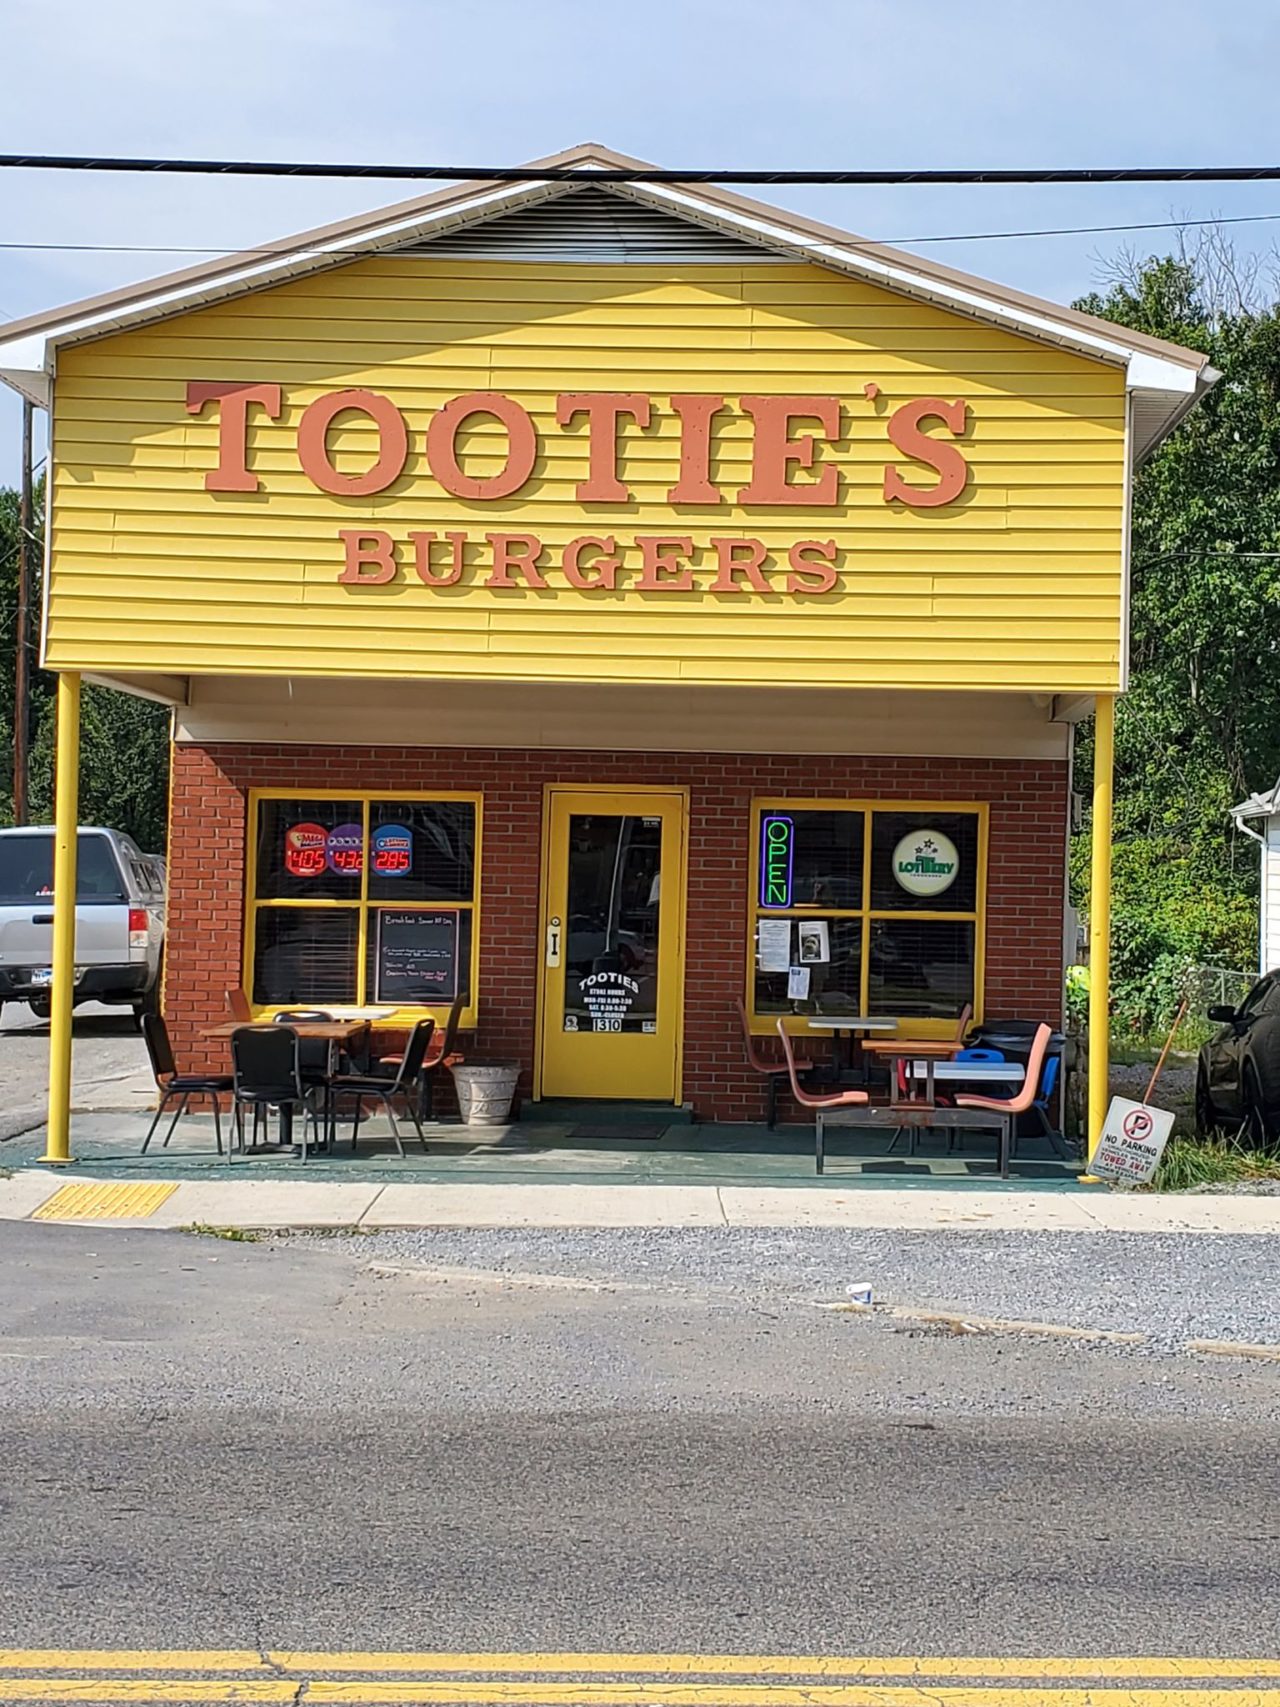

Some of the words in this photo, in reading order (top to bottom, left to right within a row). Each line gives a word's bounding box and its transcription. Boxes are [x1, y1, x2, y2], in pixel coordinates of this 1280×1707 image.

[186, 383, 967, 508] TOOTIE'S
[338, 529, 839, 594] BURGERS
[768, 822, 788, 904] OPEN
[898, 855, 955, 875] LOTTERY
[579, 972, 639, 994] TOOTIES
[593, 1019, 622, 1032] 1310
[1105, 1133, 1118, 1145] NO
[1120, 1138, 1158, 1157] PARKING
[1100, 1151, 1127, 1166] TOWED
[1129, 1161, 1151, 1174] AWAY
